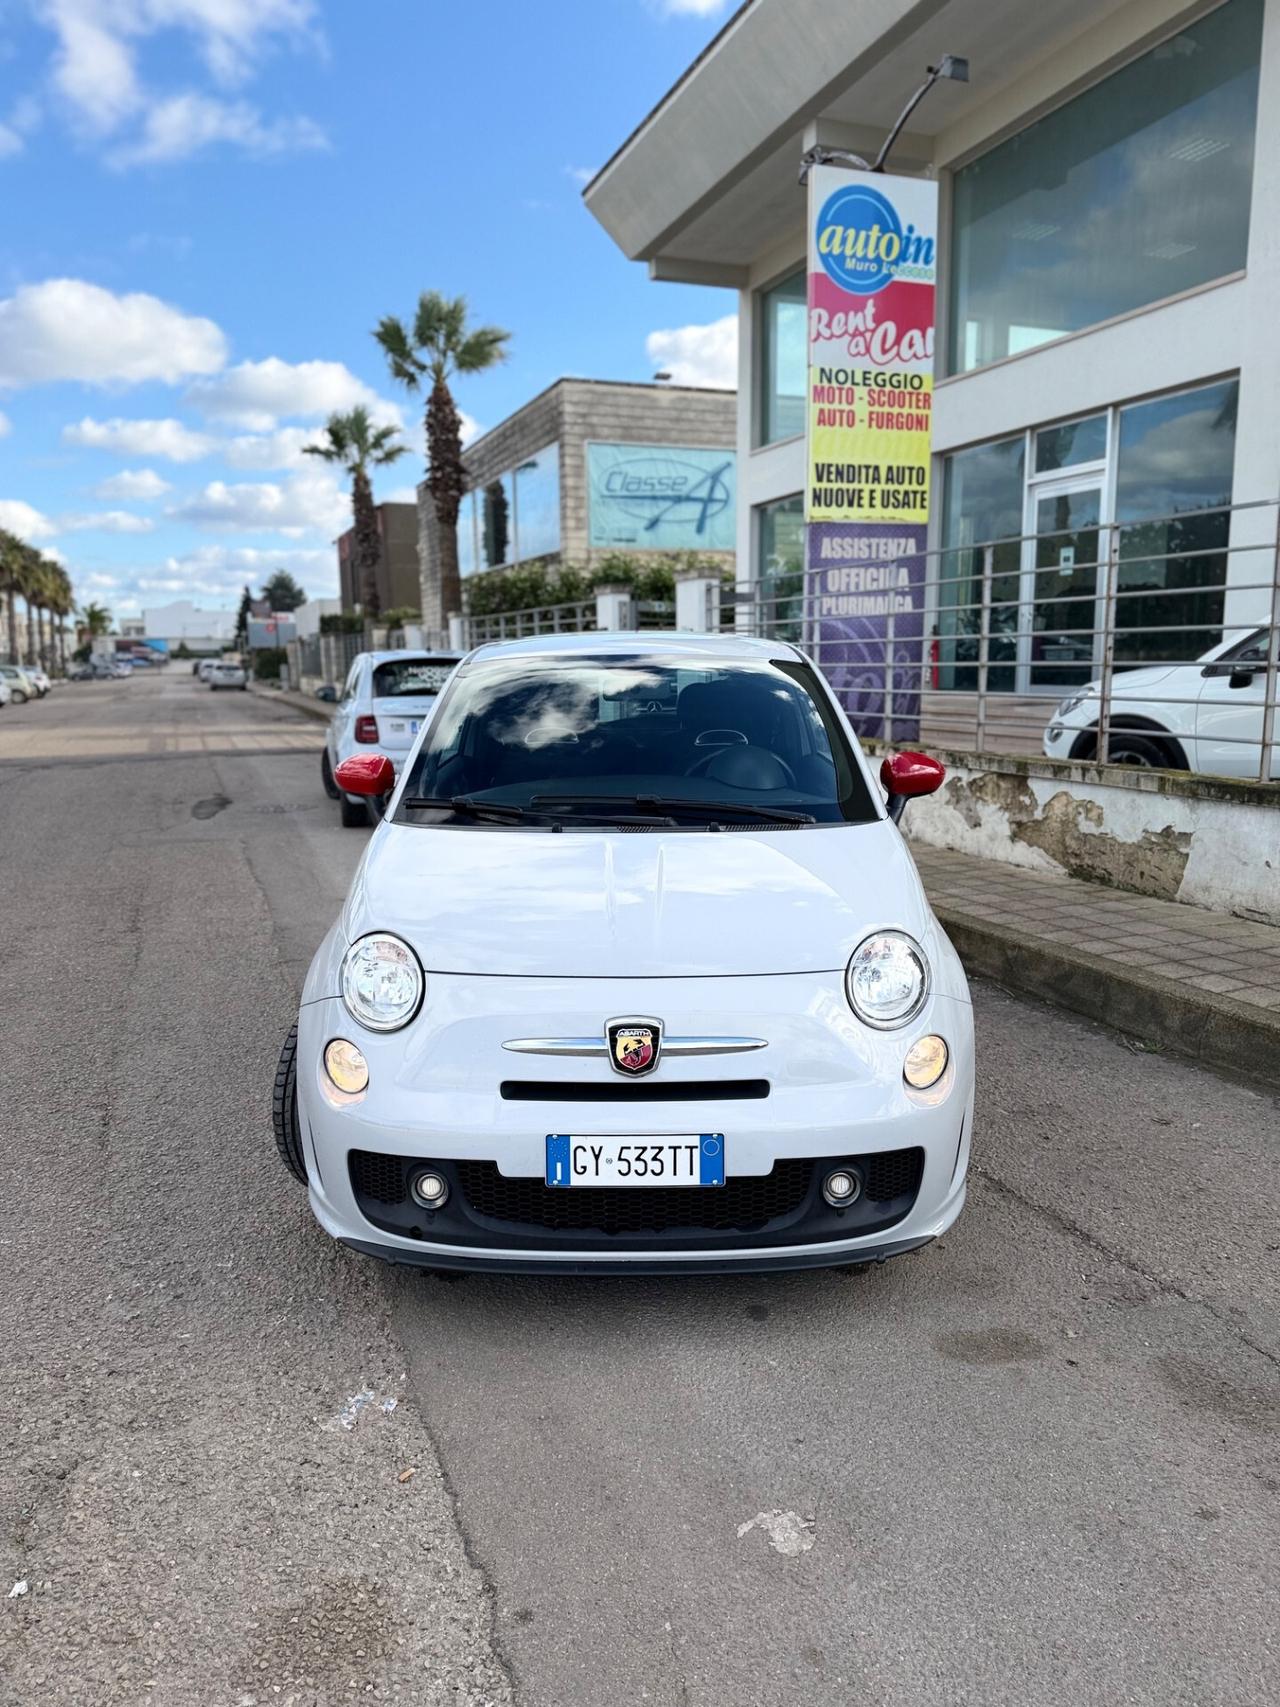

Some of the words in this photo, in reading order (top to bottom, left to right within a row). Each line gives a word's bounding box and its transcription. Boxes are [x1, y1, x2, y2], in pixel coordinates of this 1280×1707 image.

[845, 257, 878, 272] Muro
[810, 298, 876, 342] Rent
[848, 334, 868, 357] a
[819, 367, 924, 390] NOLEGGIO
[812, 385, 855, 405] MOTO
[867, 388, 931, 410] SCOOTER
[816, 408, 856, 428] AUTO
[868, 411, 929, 431] FURGONI
[604, 471, 689, 494] Classe
[815, 463, 881, 485] VENDITA
[884, 465, 926, 486] AUTO
[812, 487, 864, 508] NUOVE
[868, 489, 877, 508] E
[880, 489, 927, 509] USATE
[820, 536, 917, 559] ASSISTENZA
[573, 1145, 603, 1176] GY
[617, 1145, 699, 1176] 533TT
